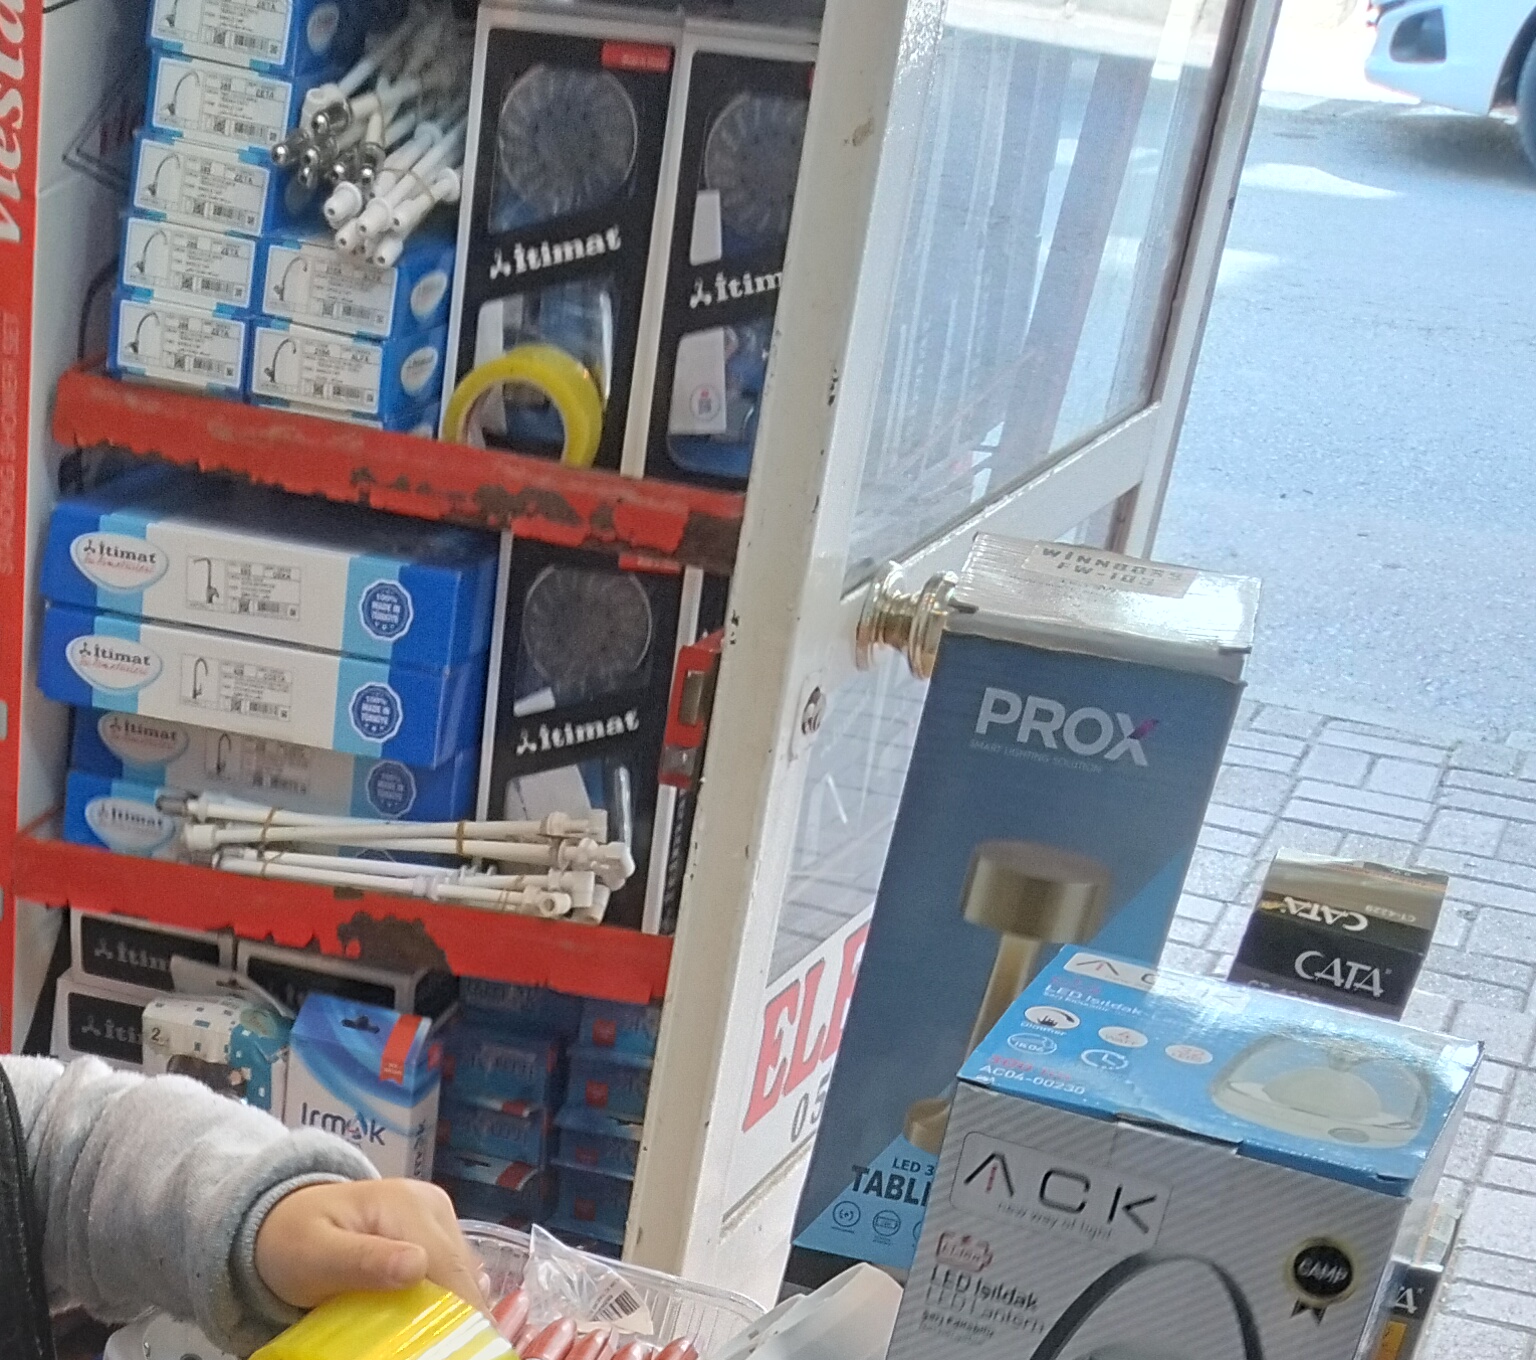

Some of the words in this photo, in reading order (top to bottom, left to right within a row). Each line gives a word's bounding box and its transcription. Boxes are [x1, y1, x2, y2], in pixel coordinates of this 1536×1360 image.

[716, 270, 783, 304] İtim
[975, 687, 1159, 767] PROX
[1284, 896, 1368, 931] CATA
[1295, 950, 1384, 997] CATA
[1045, 984, 1083, 1001] LED
[979, 1065, 1086, 1096] AC04-00230
[893, 1157, 920, 1173] LED
[964, 1152, 1158, 1234] ACK
[931, 1266, 971, 1294] LED
[1299, 1258, 1349, 1286] CAMP
[926, 1287, 967, 1314] LED
